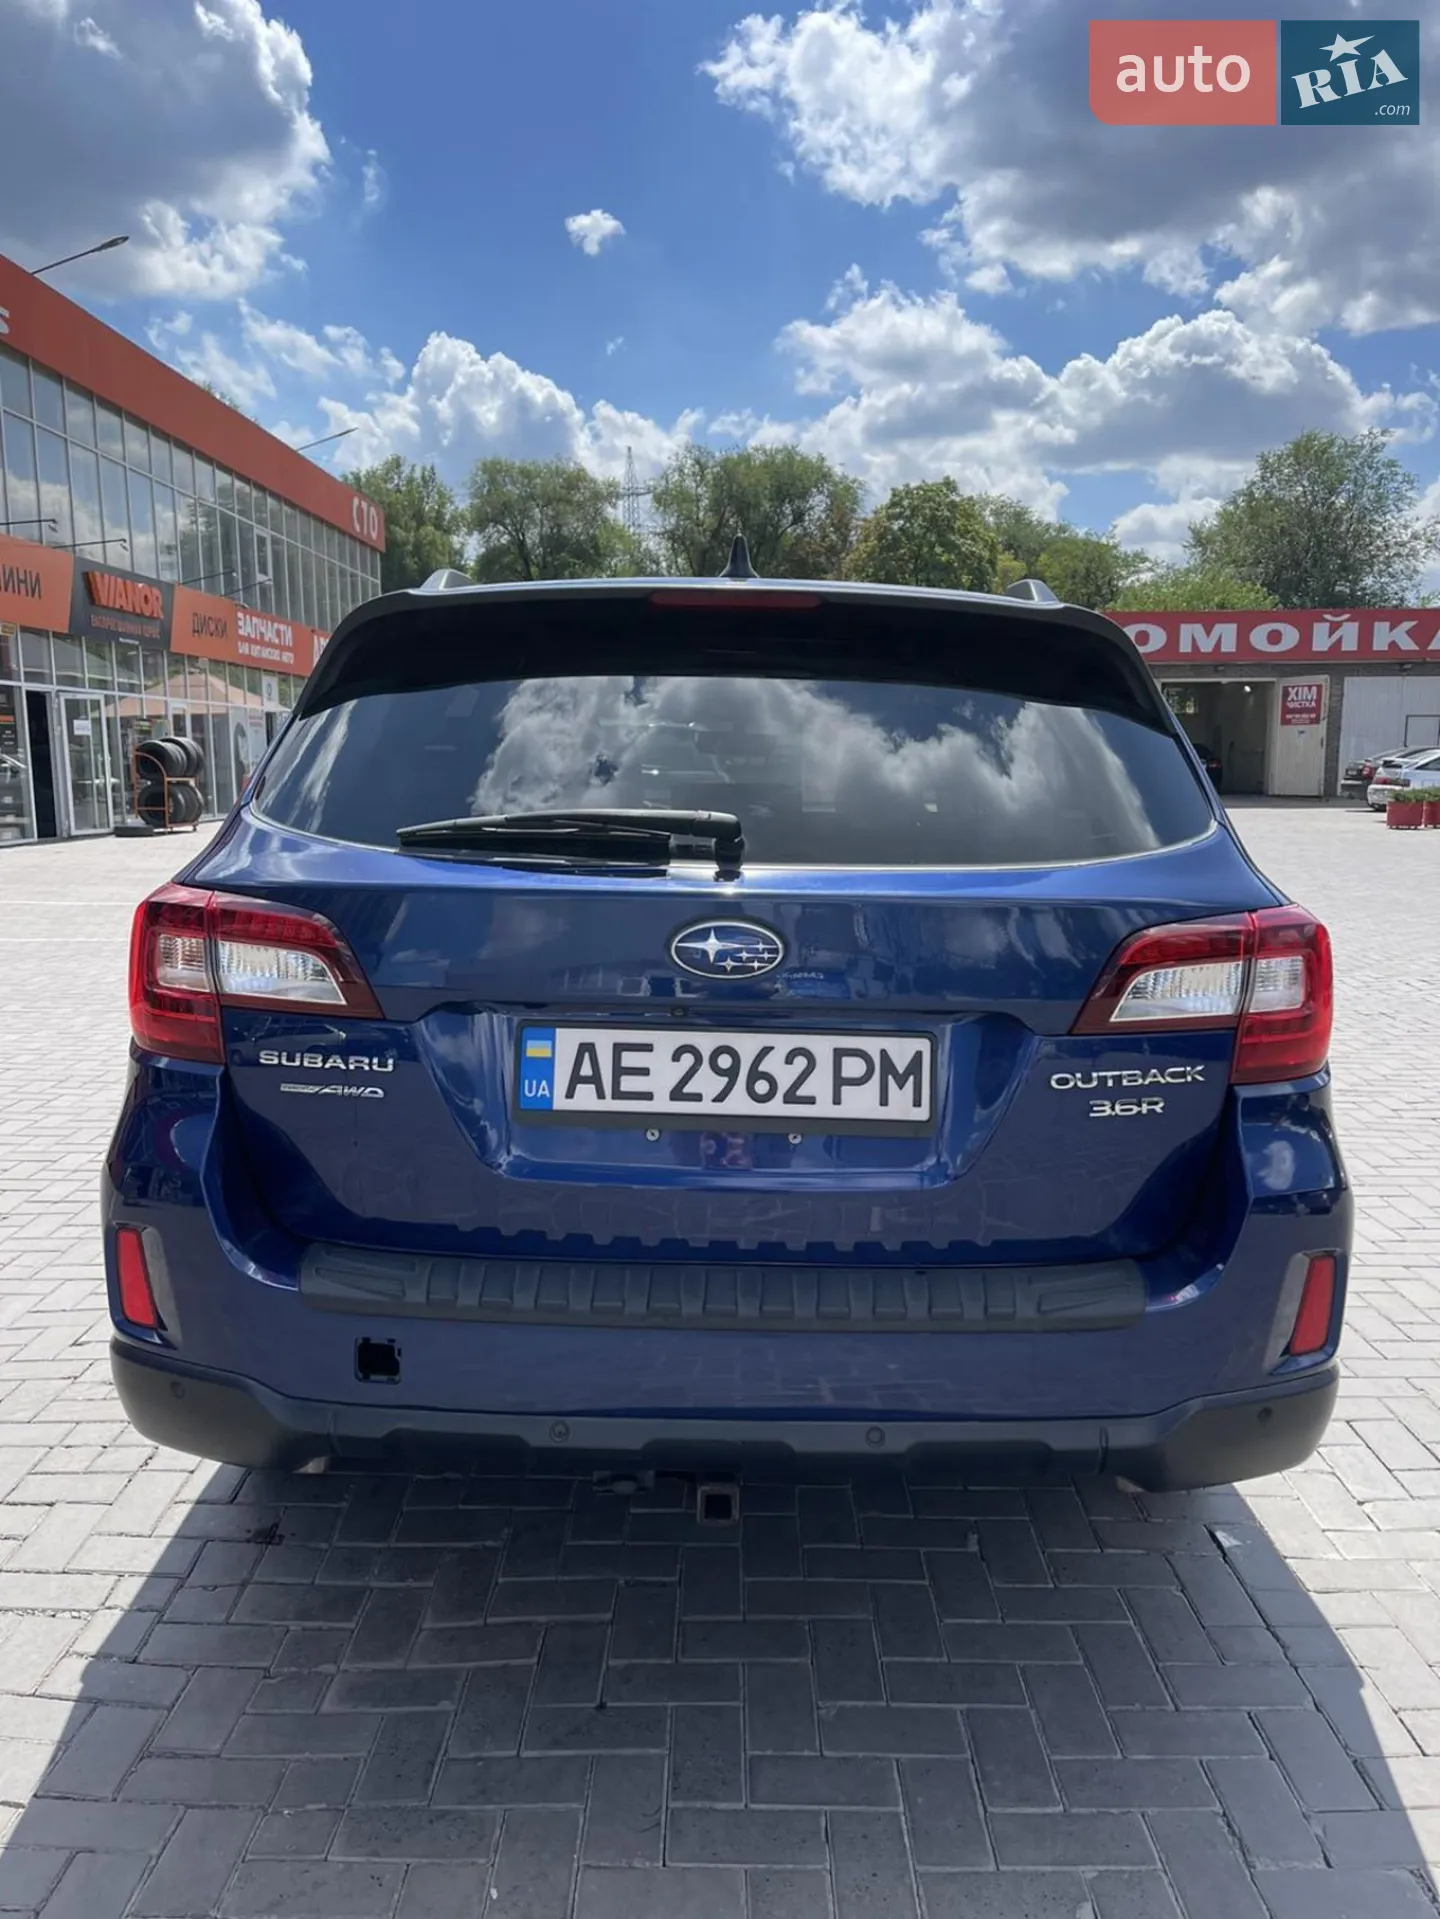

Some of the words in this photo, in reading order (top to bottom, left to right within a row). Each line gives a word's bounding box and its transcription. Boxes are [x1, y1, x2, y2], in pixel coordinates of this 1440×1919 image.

[353, 495, 378, 540] СТО
[0, 564, 42, 600] ИНИ
[84, 570, 164, 619] VIANOR
[192, 612, 228, 639] ДИСКИ
[237, 611, 293, 647] ЗАПЧАСТИ
[1287, 686, 1317, 701] ХІМ
[259, 1050, 394, 1072] SUBARU
[564, 1042, 655, 1101] AE
[669, 1043, 818, 1106] 2962
[832, 1047, 923, 1108] PM
[1050, 1065, 1205, 1090] OUTBACK
[319, 1084, 384, 1098] AWD
[523, 1079, 550, 1098] UA
[1089, 1097, 1165, 1117] 3.6R
